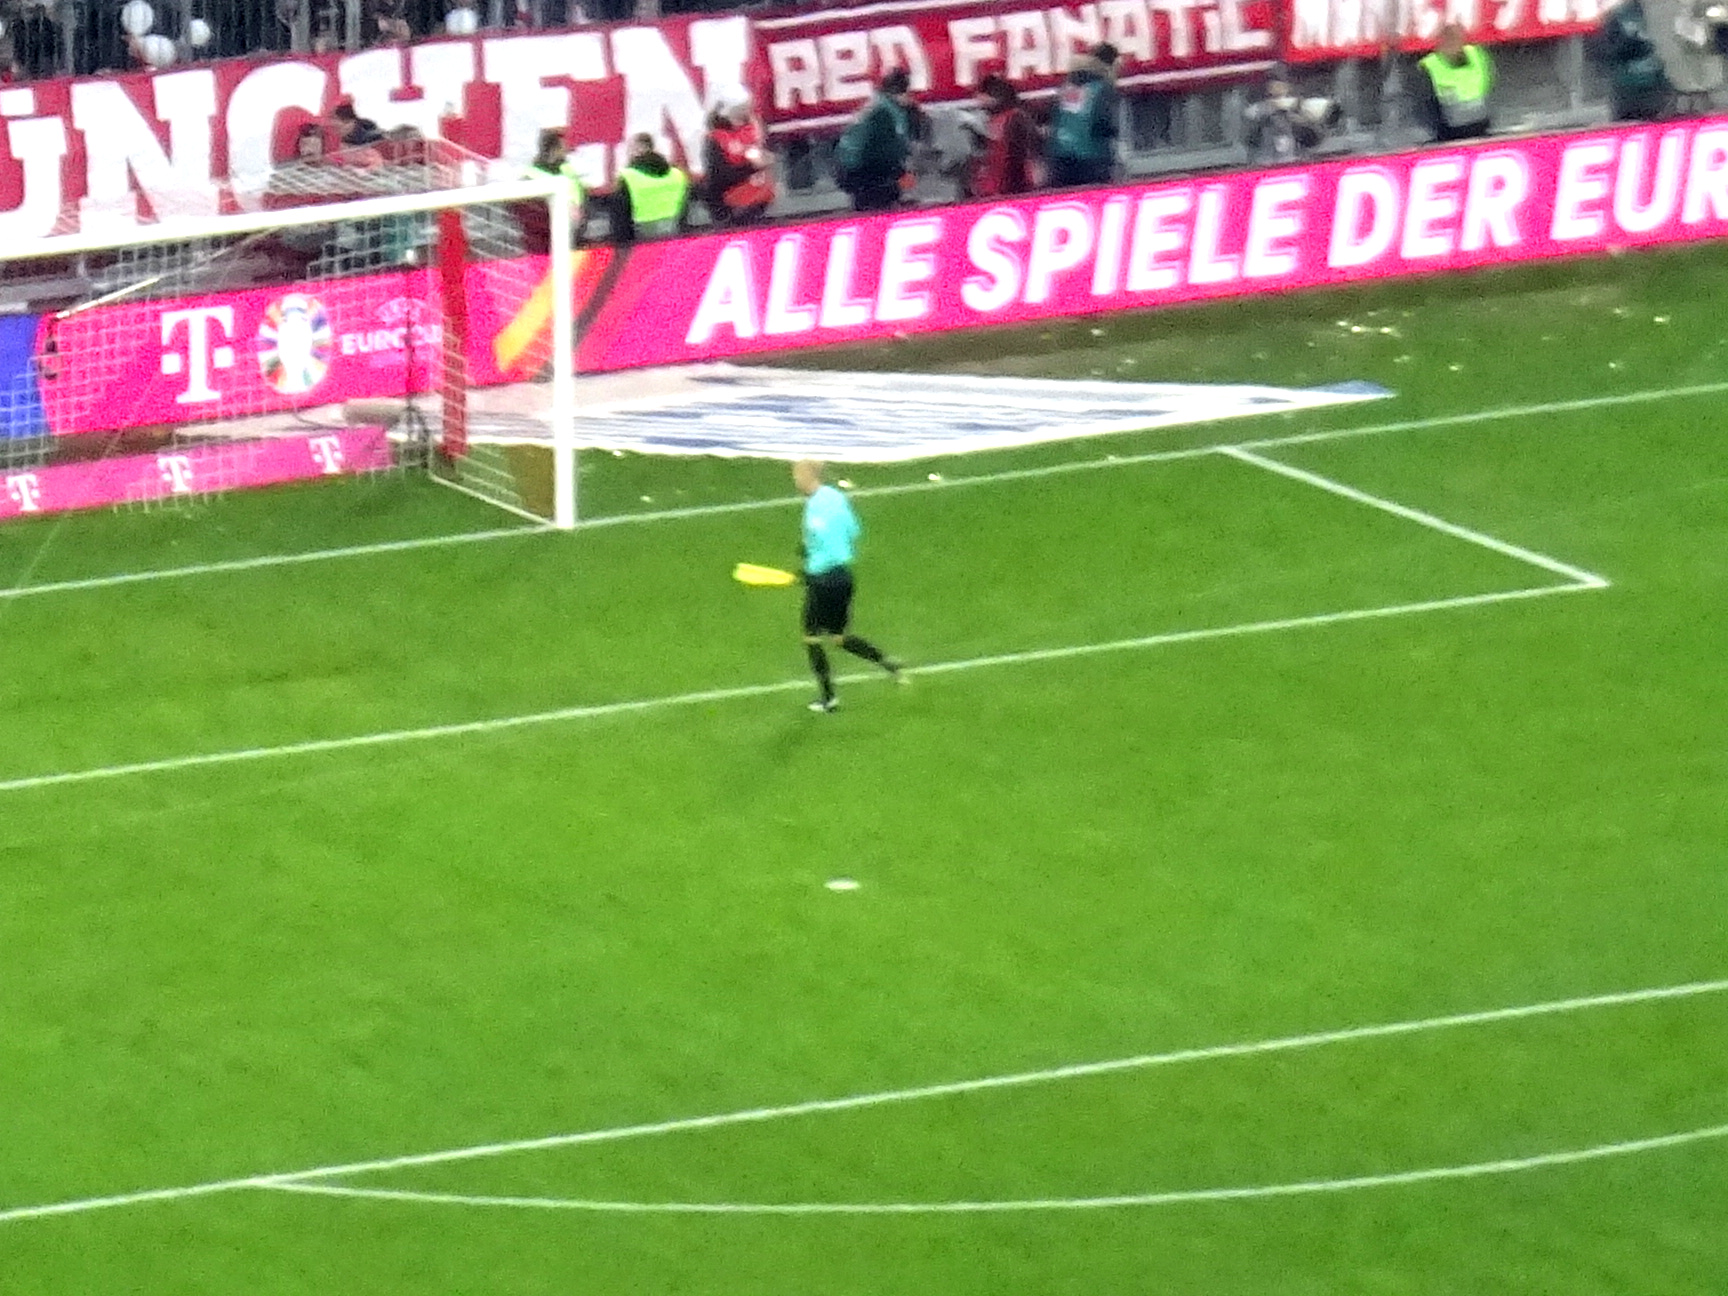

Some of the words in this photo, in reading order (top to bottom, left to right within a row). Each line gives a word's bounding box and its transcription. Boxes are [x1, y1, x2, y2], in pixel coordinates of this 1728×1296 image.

[685, 216, 942, 346] ALLE
[960, 173, 1311, 312] SPIELE
[1327, 150, 1530, 269] DER
[1549, 122, 1728, 242] EUR
